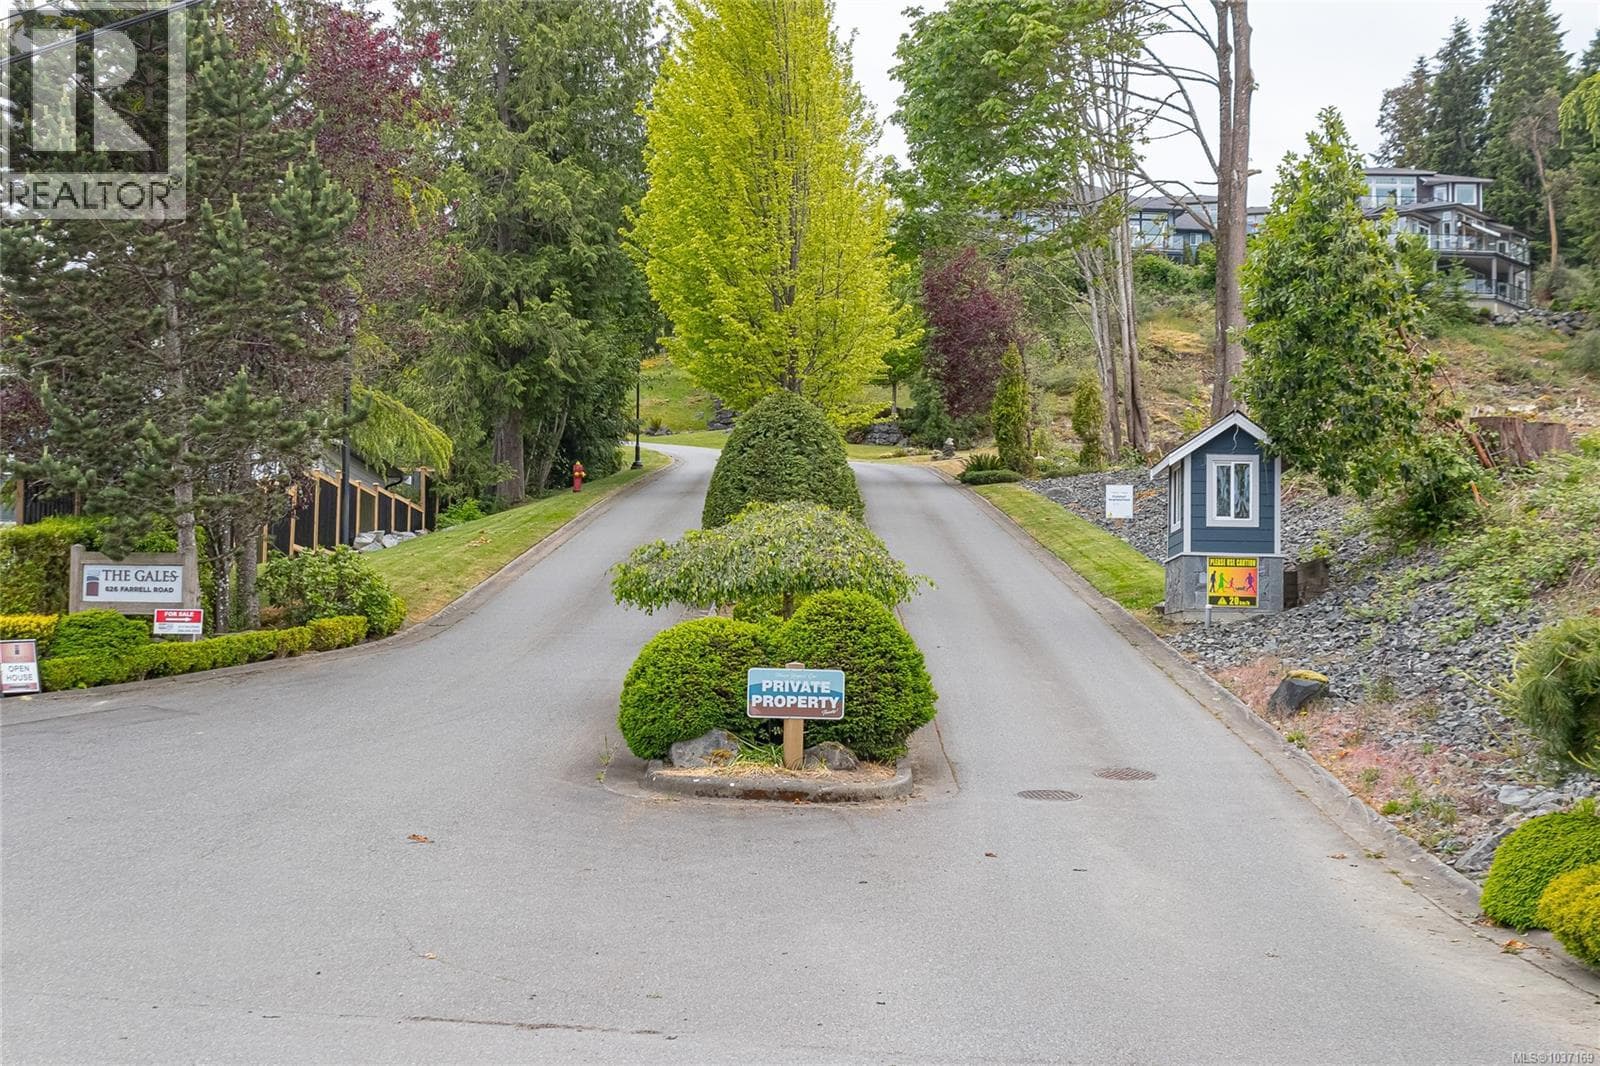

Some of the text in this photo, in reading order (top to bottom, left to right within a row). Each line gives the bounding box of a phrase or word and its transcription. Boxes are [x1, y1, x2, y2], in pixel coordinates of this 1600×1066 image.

[101, 569, 179, 583] THE GALES
[761, 680, 831, 693] PRIVATE
[751, 695, 839, 709] PROPERTY
